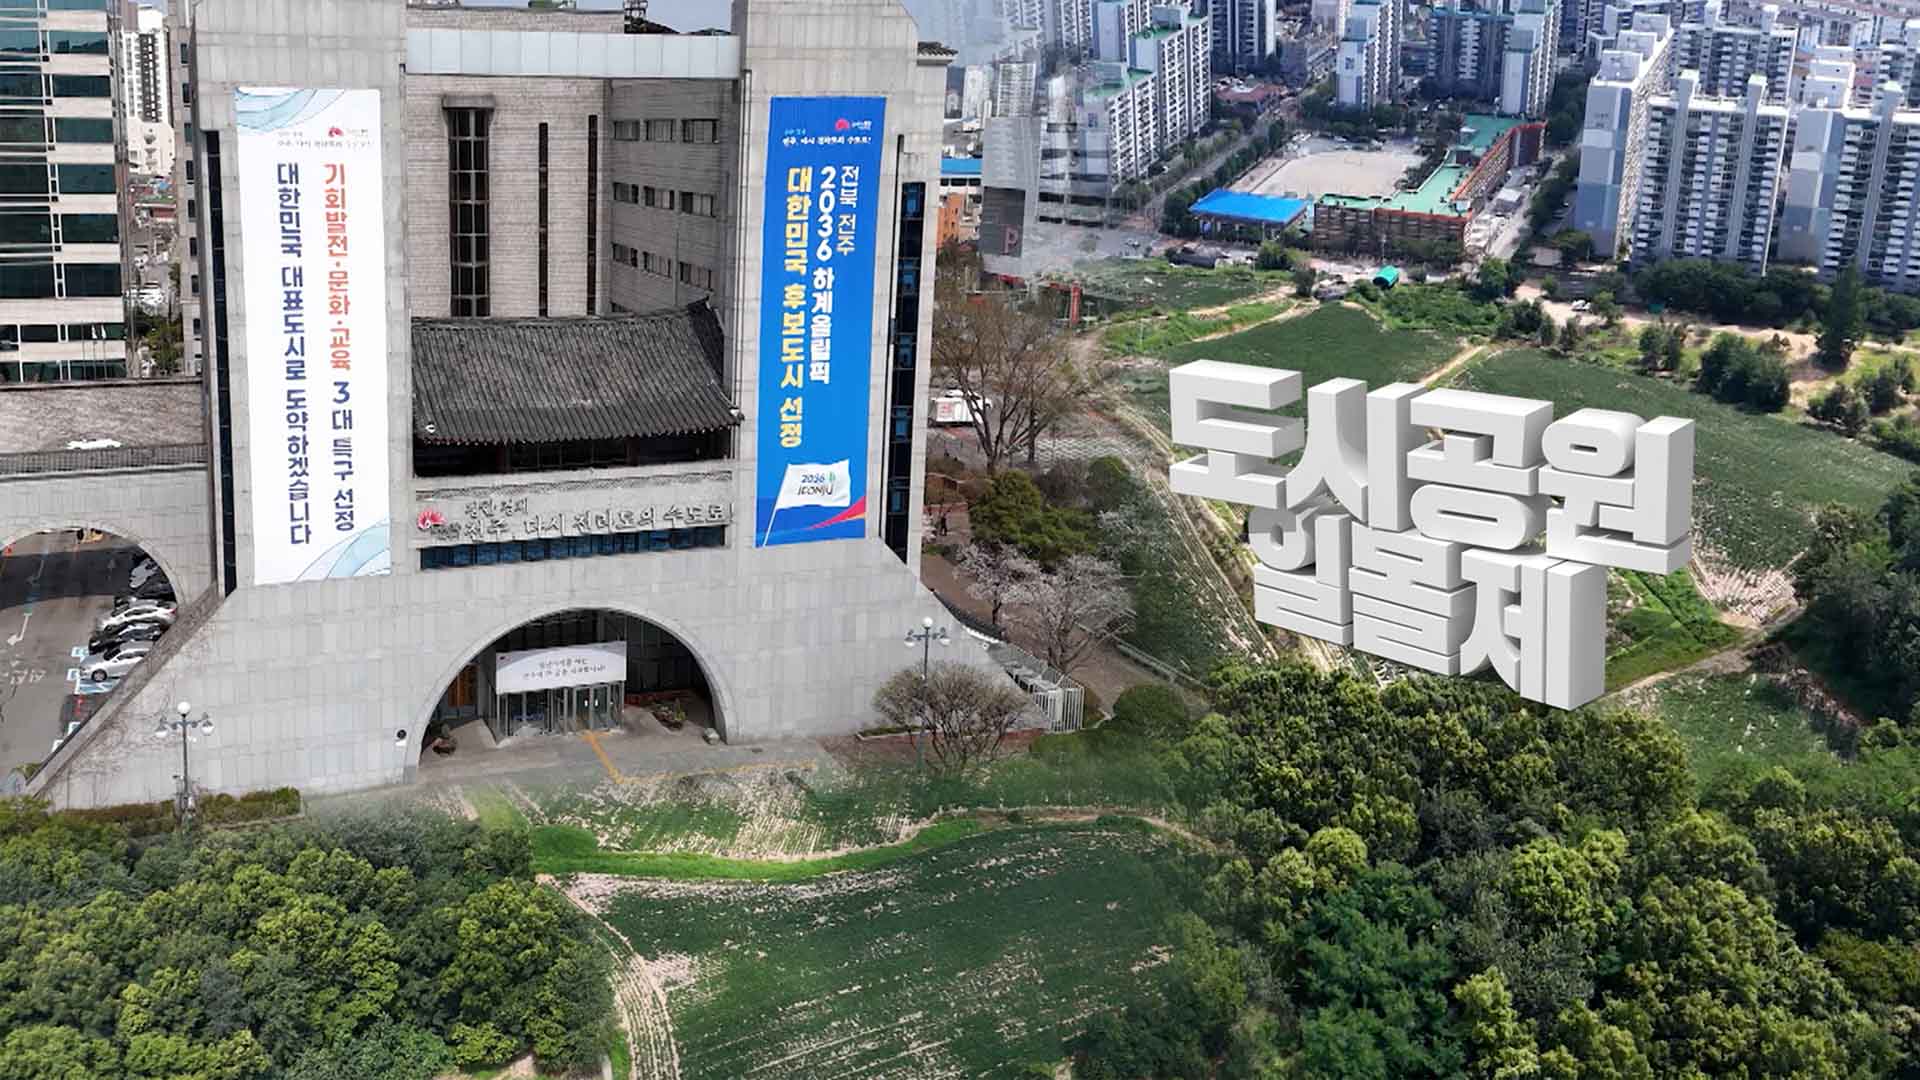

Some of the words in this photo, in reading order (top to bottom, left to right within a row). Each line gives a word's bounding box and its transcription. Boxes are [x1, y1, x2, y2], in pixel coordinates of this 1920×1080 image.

[276, 162, 303, 259] 대한민국
[784, 166, 813, 276] 대한민국
[815, 165, 837, 262] 2036
[836, 213, 857, 256] 전주
[839, 165, 860, 208] 전북
[281, 265, 307, 381] 대표도시로
[780, 283, 807, 388] 후보도시
[809, 266, 835, 385] 하계올림픽
[285, 389, 312, 545] 도약하겠습니다
[331, 437, 355, 482] 특구
[779, 396, 803, 448] 선정
[333, 488, 355, 532] 선정
[523, 512, 566, 538] 다시
